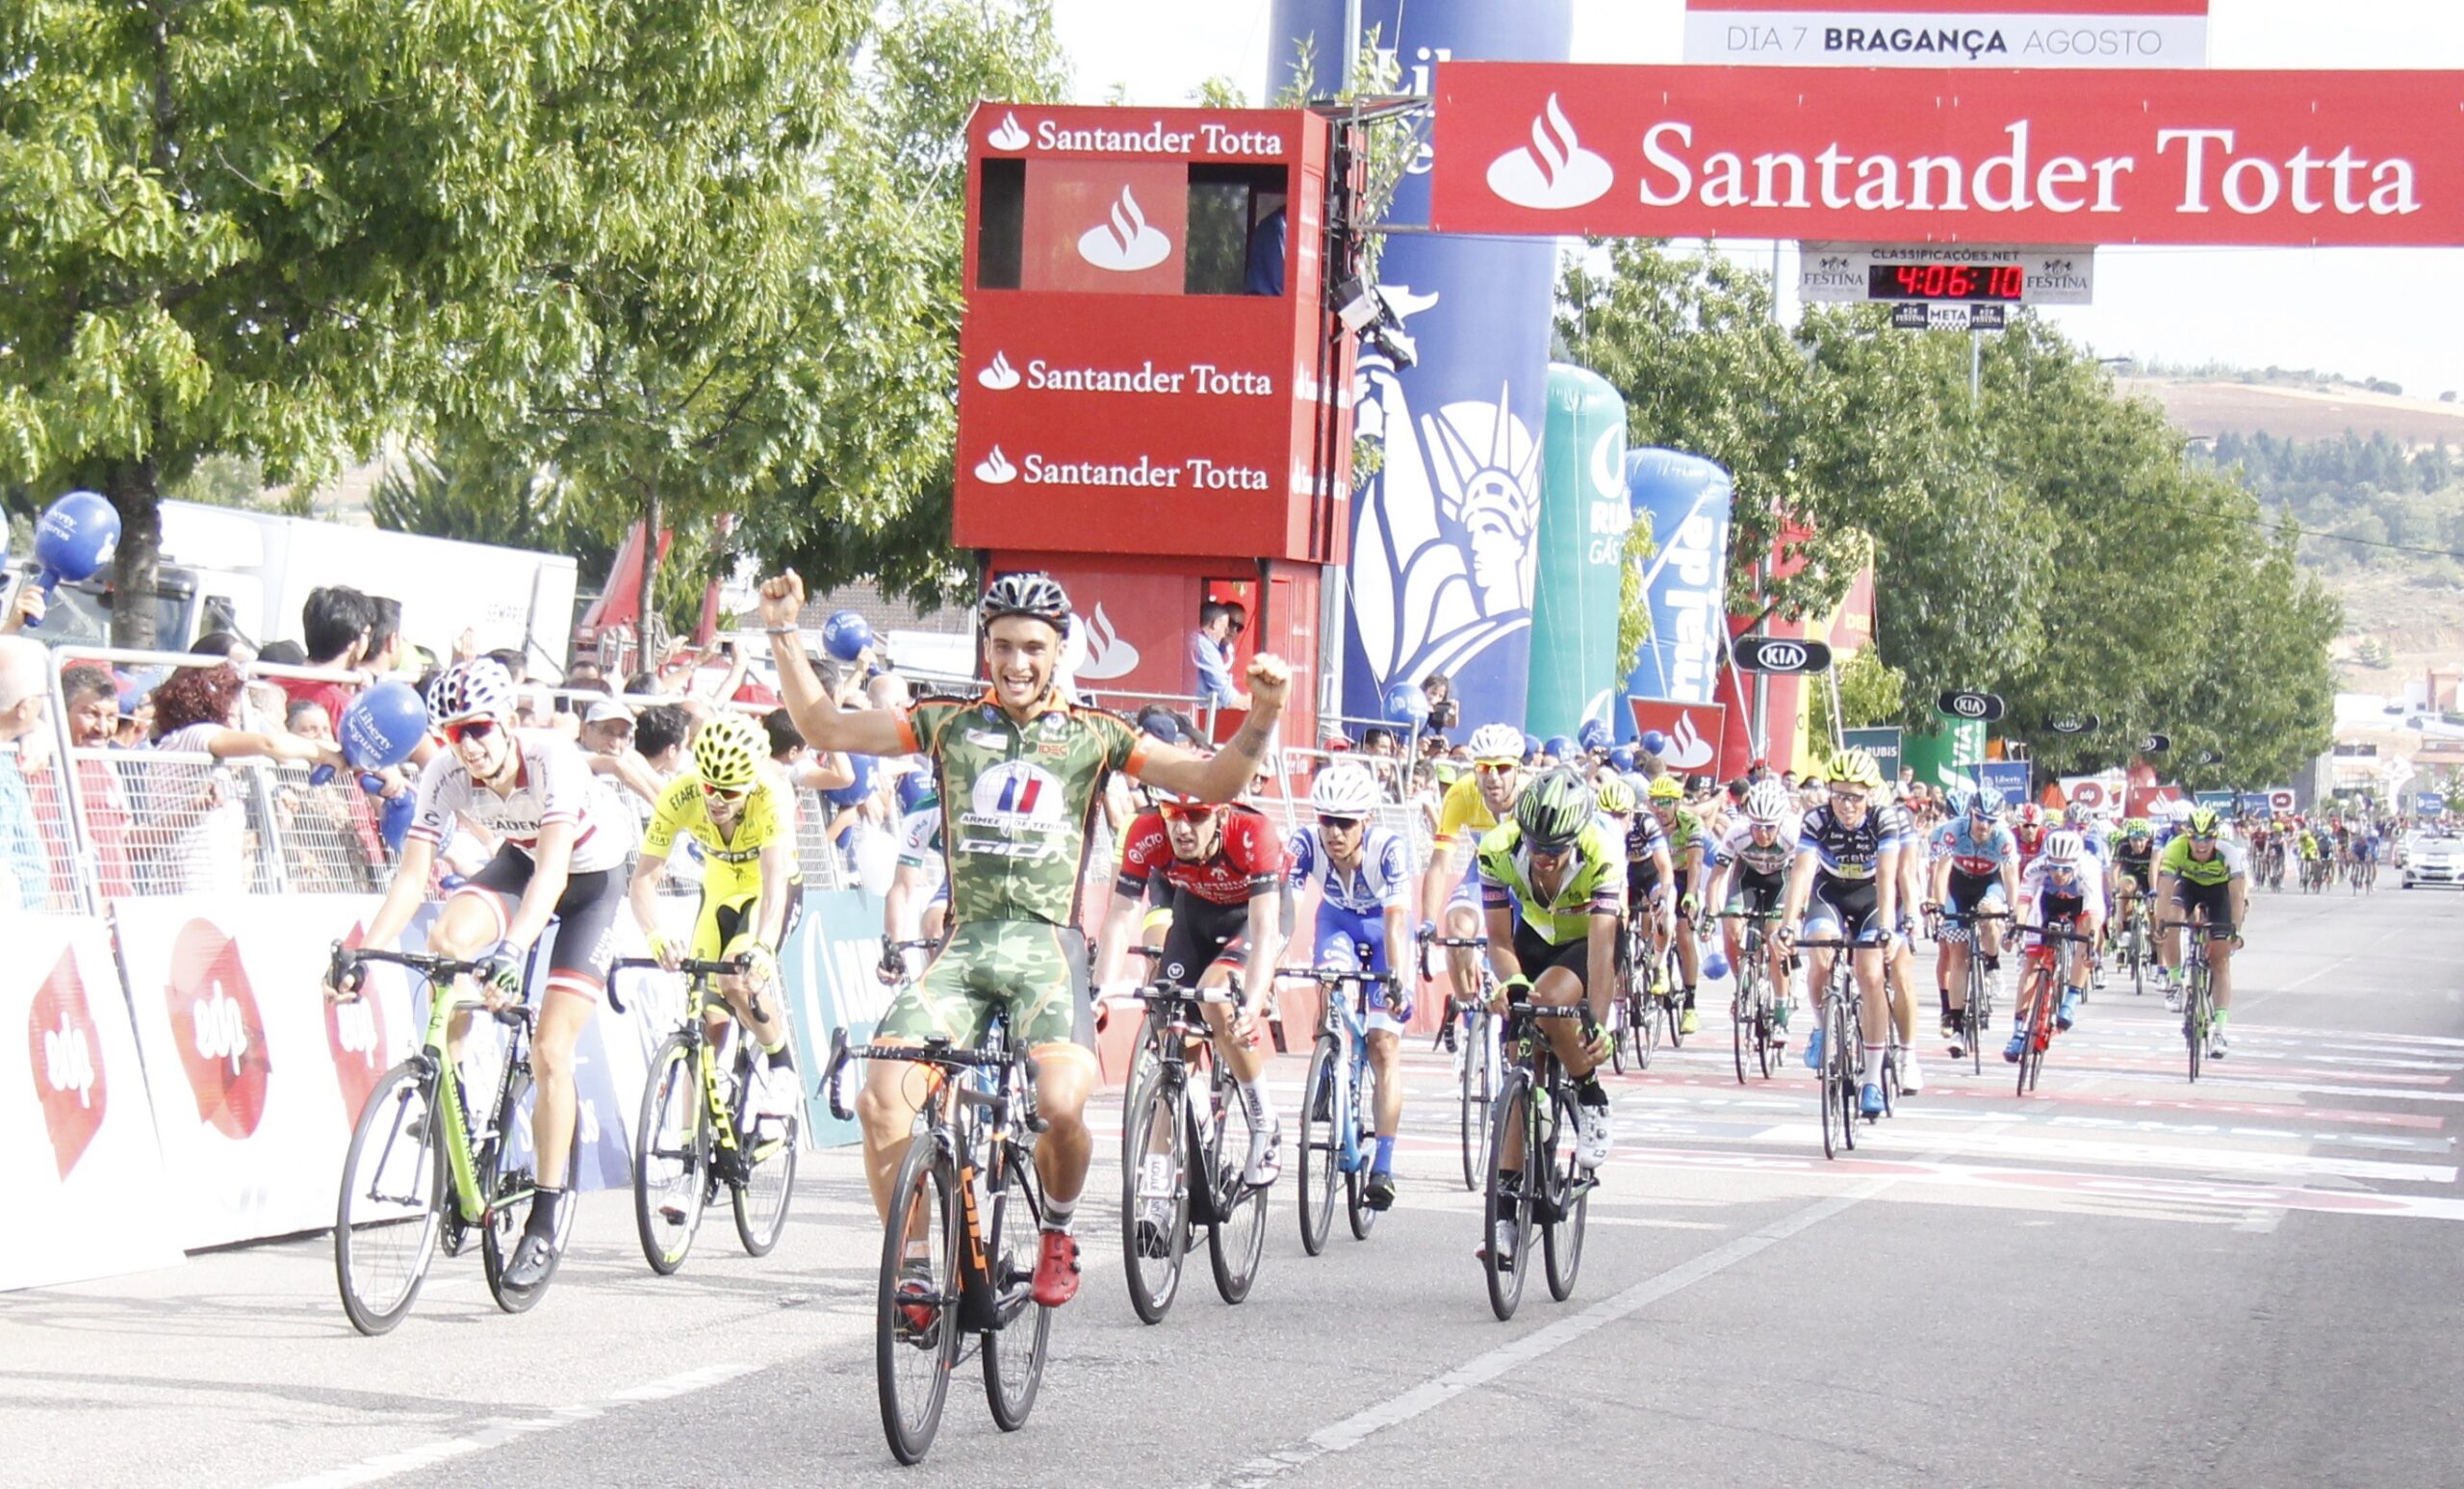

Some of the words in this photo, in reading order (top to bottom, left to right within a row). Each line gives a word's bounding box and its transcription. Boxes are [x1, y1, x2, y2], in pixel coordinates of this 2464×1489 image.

[1728, 26, 1782, 51] DIA
[1792, 27, 1808, 51] 7
[1824, 28, 2007, 60] BRAGANÇA
[2023, 30, 2163, 56] AGOSTO
[1037, 119, 1194, 154] Santander
[1200, 124, 1282, 155] Totta
[1639, 119, 2136, 214] Santander
[2154, 127, 2421, 217] Totta
[1804, 272, 1863, 286] FESTINA
[1896, 266, 2023, 297] 4:06:10
[2027, 275, 2087, 289] FESTINA
[1930, 309, 1967, 321] META
[1027, 360, 1184, 394] Santander
[1191, 364, 1272, 396] Totta
[1023, 454, 1180, 488] Santander
[1186, 458, 1269, 491] Totta
[1765, 646, 1800, 665] KIA
[1959, 699, 1981, 713] KIA
[347, 716, 383, 760] Seguros
[357, 706, 394, 750] Liberty
[193, 979, 247, 1076] edp
[44, 1011, 94, 1109] edp
[703, 1045, 738, 1150] SCOTT
